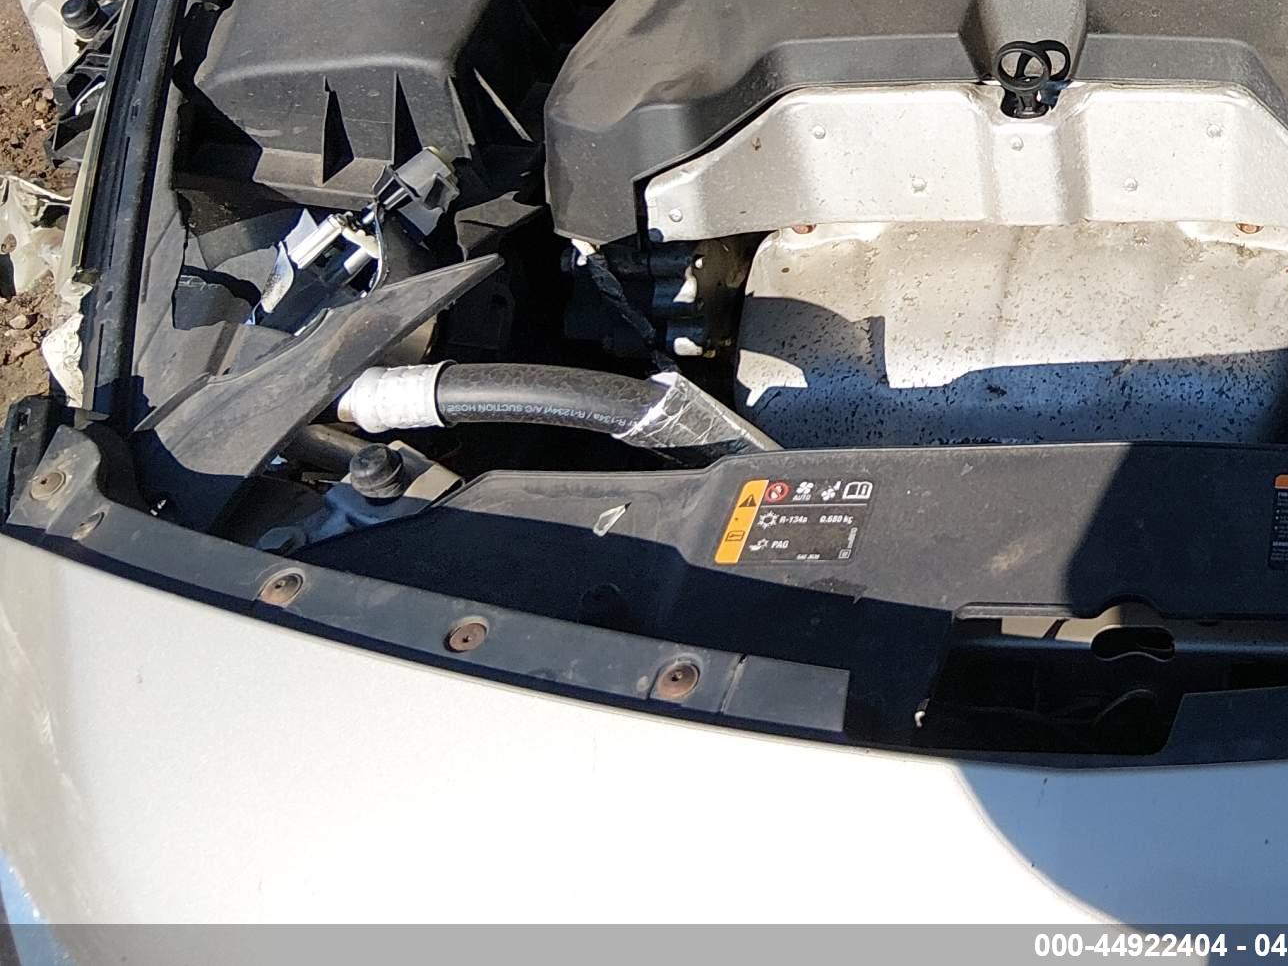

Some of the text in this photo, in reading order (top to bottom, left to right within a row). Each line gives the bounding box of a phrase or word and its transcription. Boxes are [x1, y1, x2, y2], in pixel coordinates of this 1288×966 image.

[447, 404, 477, 413] HOSE
[478, 404, 524, 413] SUCTION
[525, 404, 543, 414] A/C
[779, 515, 808, 524] R-134a
[842, 515, 854, 525] kg
[771, 540, 789, 549] PAG
